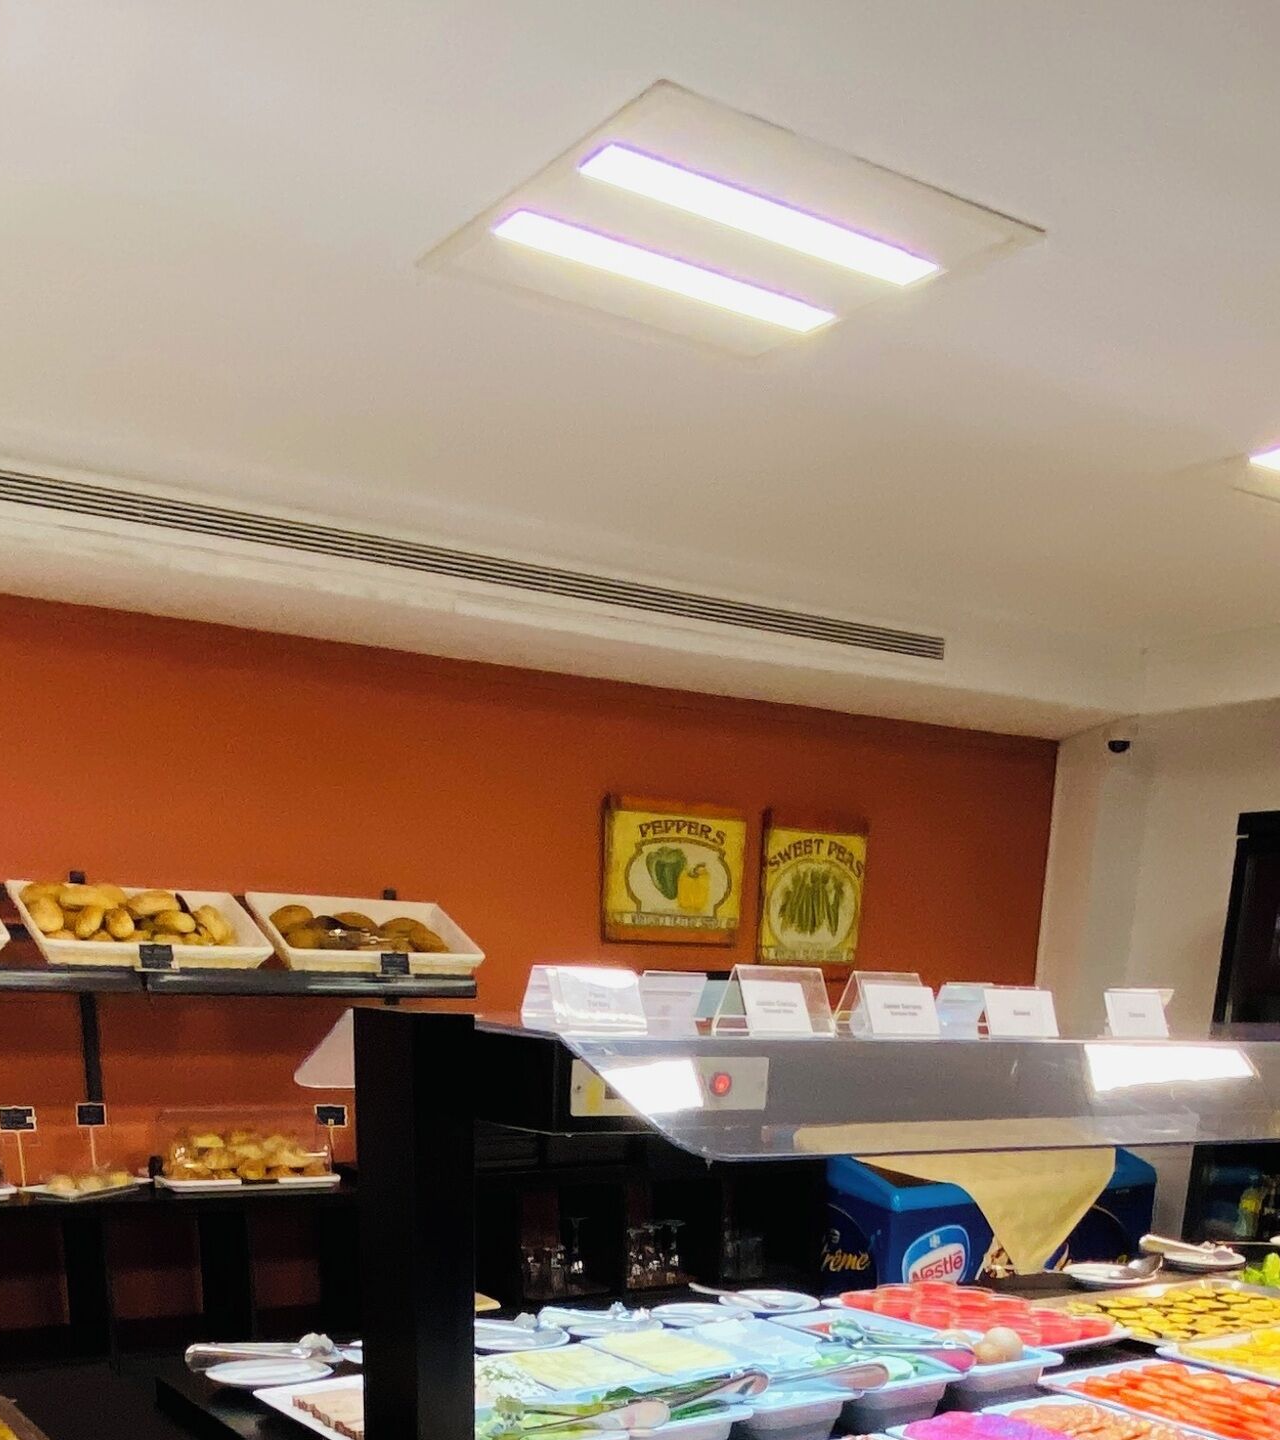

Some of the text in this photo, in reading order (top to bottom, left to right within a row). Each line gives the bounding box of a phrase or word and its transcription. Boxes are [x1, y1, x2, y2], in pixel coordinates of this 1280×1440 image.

[638, 819, 727, 847] PEPPERS
[768, 838, 865, 878] SWEET PEAS
